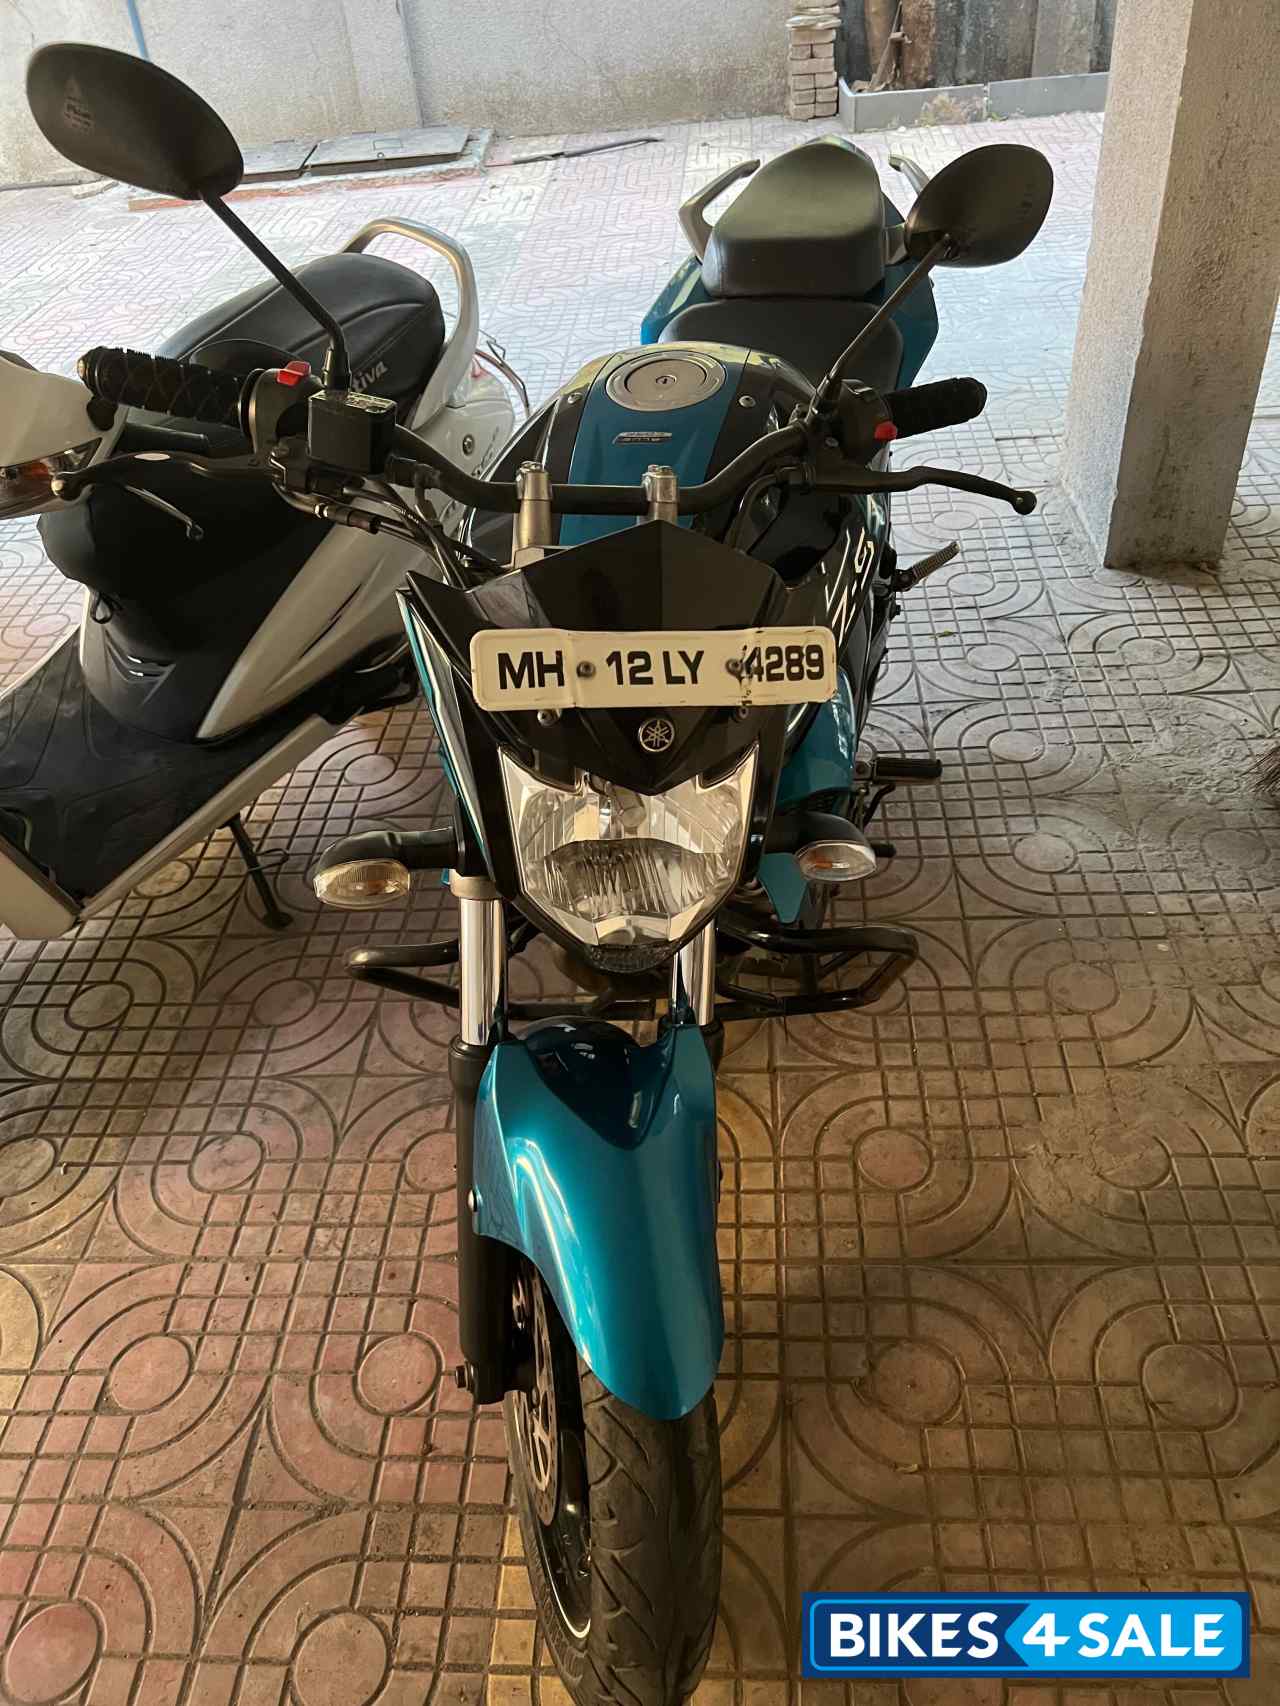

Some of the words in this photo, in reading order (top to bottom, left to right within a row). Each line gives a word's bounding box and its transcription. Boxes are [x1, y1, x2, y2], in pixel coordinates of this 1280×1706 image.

[352, 361, 389, 393] tiva
[498, 650, 565, 690] MH
[743, 644, 824, 683] 4289
